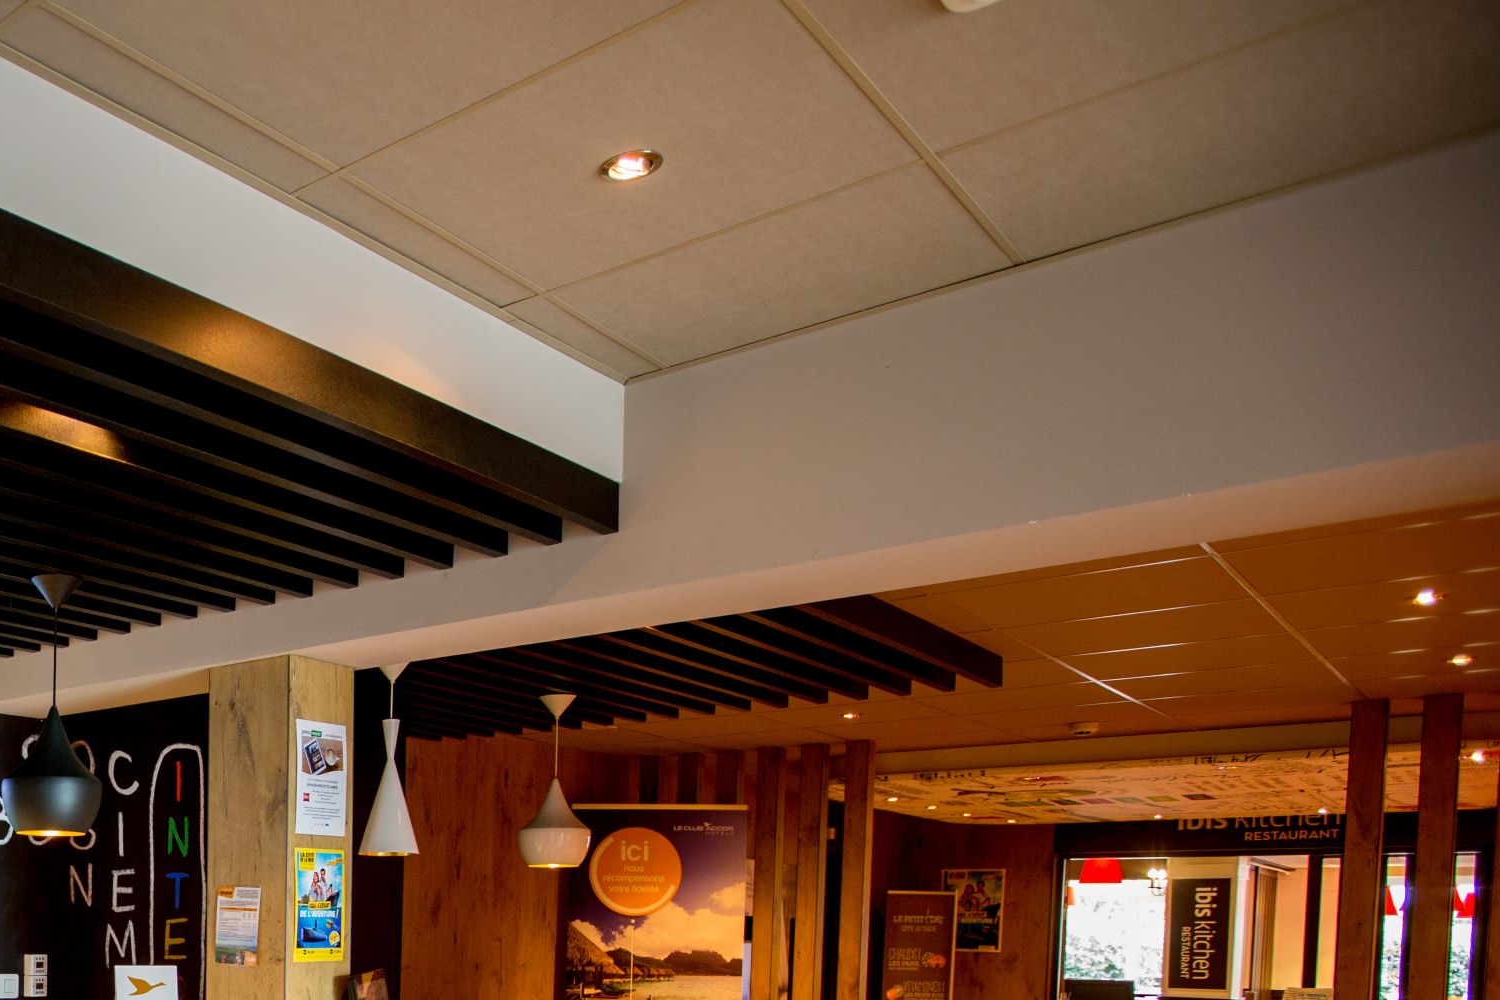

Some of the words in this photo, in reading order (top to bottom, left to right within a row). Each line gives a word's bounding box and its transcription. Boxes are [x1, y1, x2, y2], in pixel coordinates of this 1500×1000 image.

[1244, 829, 1340, 841] RESTAURANT
[620, 840, 649, 862] ici
[603, 874, 665, 884] récompensons
[609, 885, 631, 893] votre
[631, 884, 660, 893] fidélité
[1194, 887, 1218, 918] ibis
[1180, 926, 1191, 979] RESTAURANT
[1192, 921, 1217, 980] kitchen
